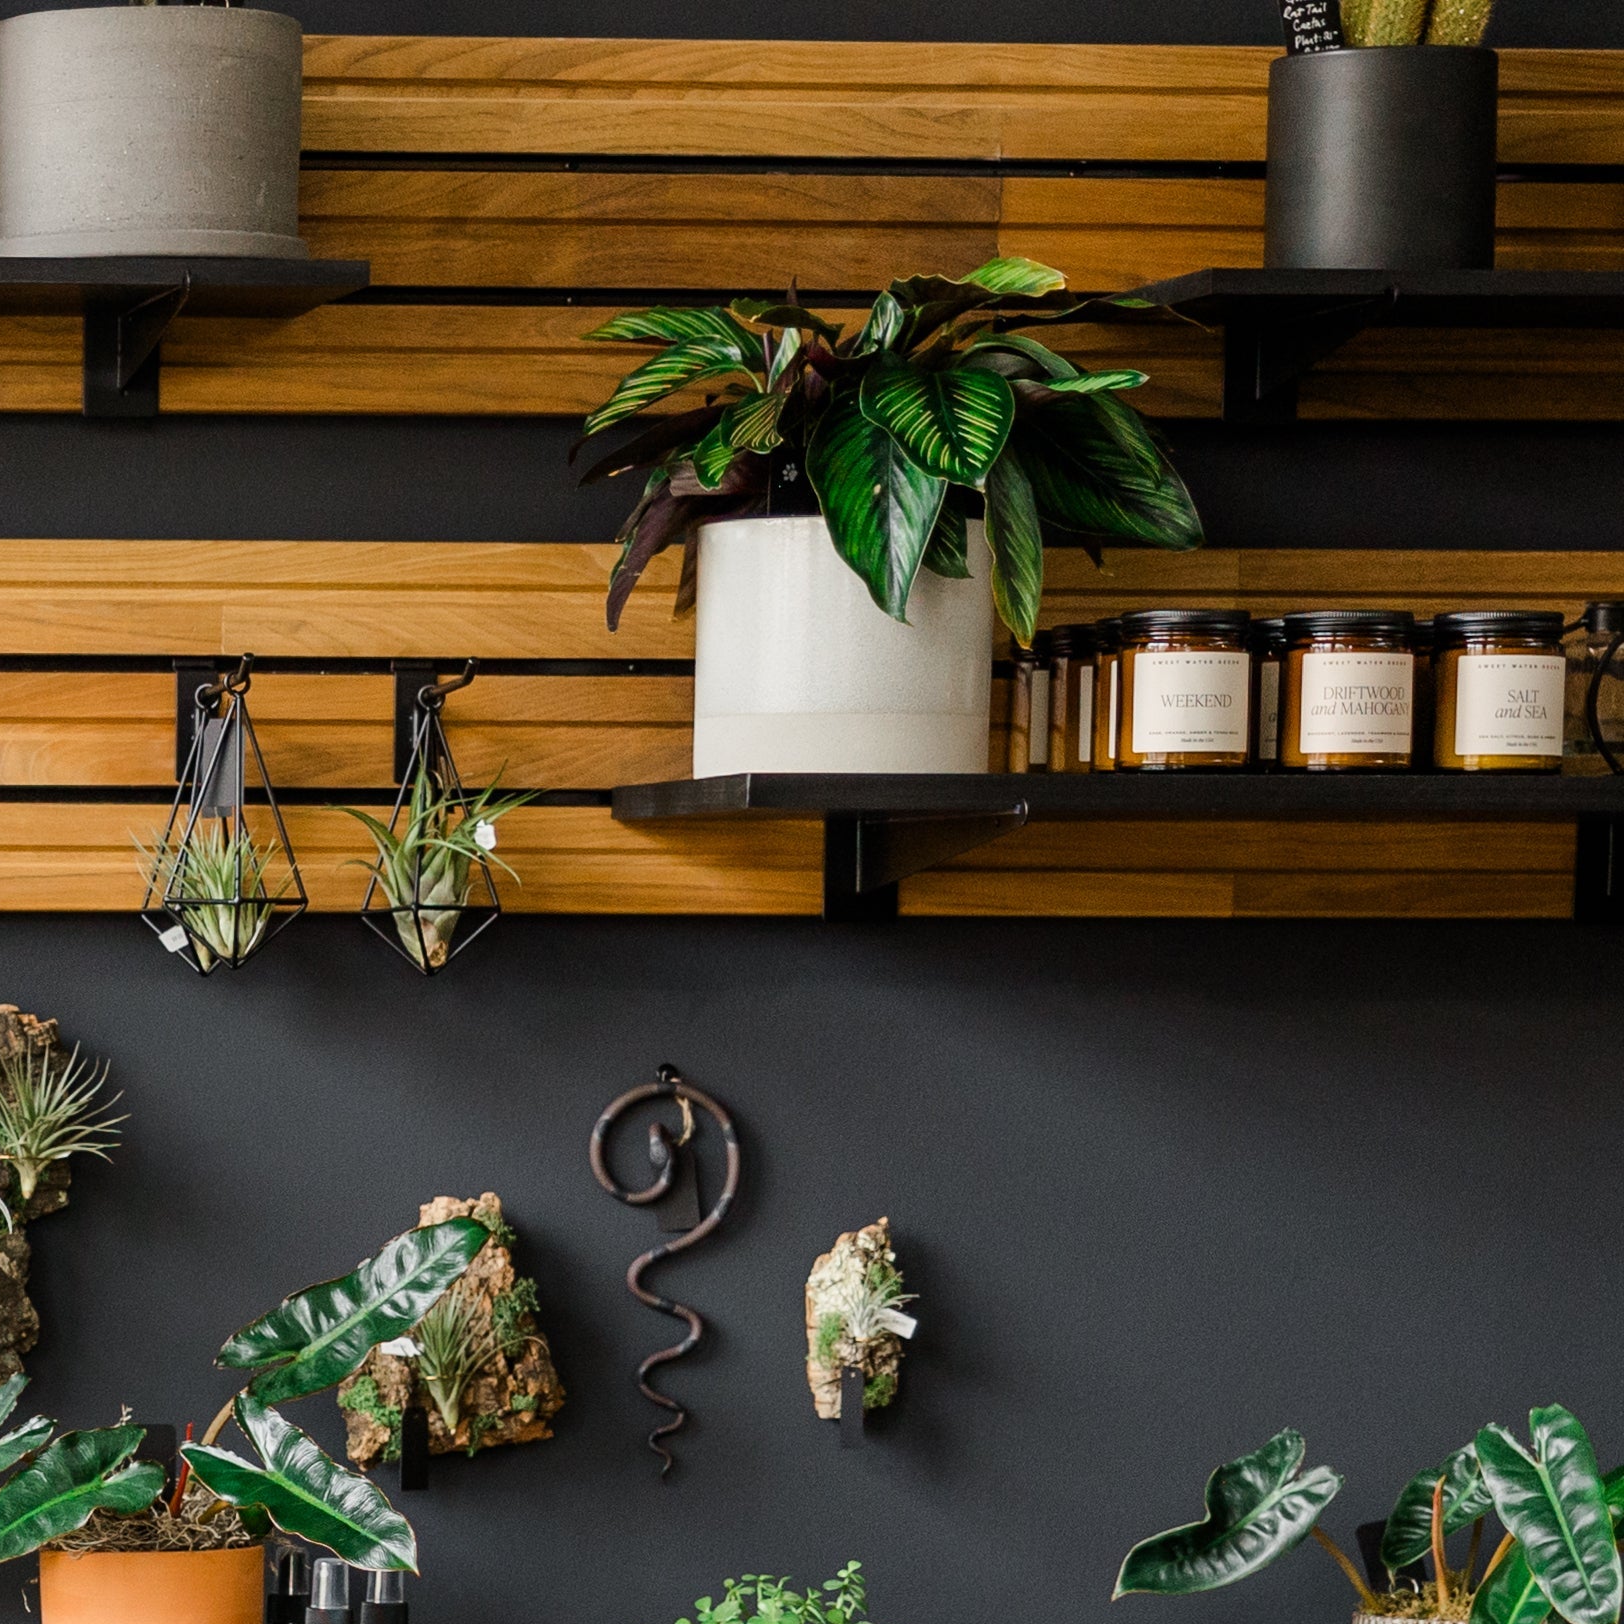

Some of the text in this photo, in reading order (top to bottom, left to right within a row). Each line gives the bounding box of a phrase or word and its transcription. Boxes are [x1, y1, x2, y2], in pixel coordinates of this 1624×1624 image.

[1305, 2, 1327, 15] Tail
[1324, 686, 1405, 700] DRIFTWOOD
[1508, 689, 1539, 703] SALT
[1161, 694, 1232, 708] WEEKEND
[1311, 702, 1336, 716] and
[1495, 705, 1547, 719] and SEA
